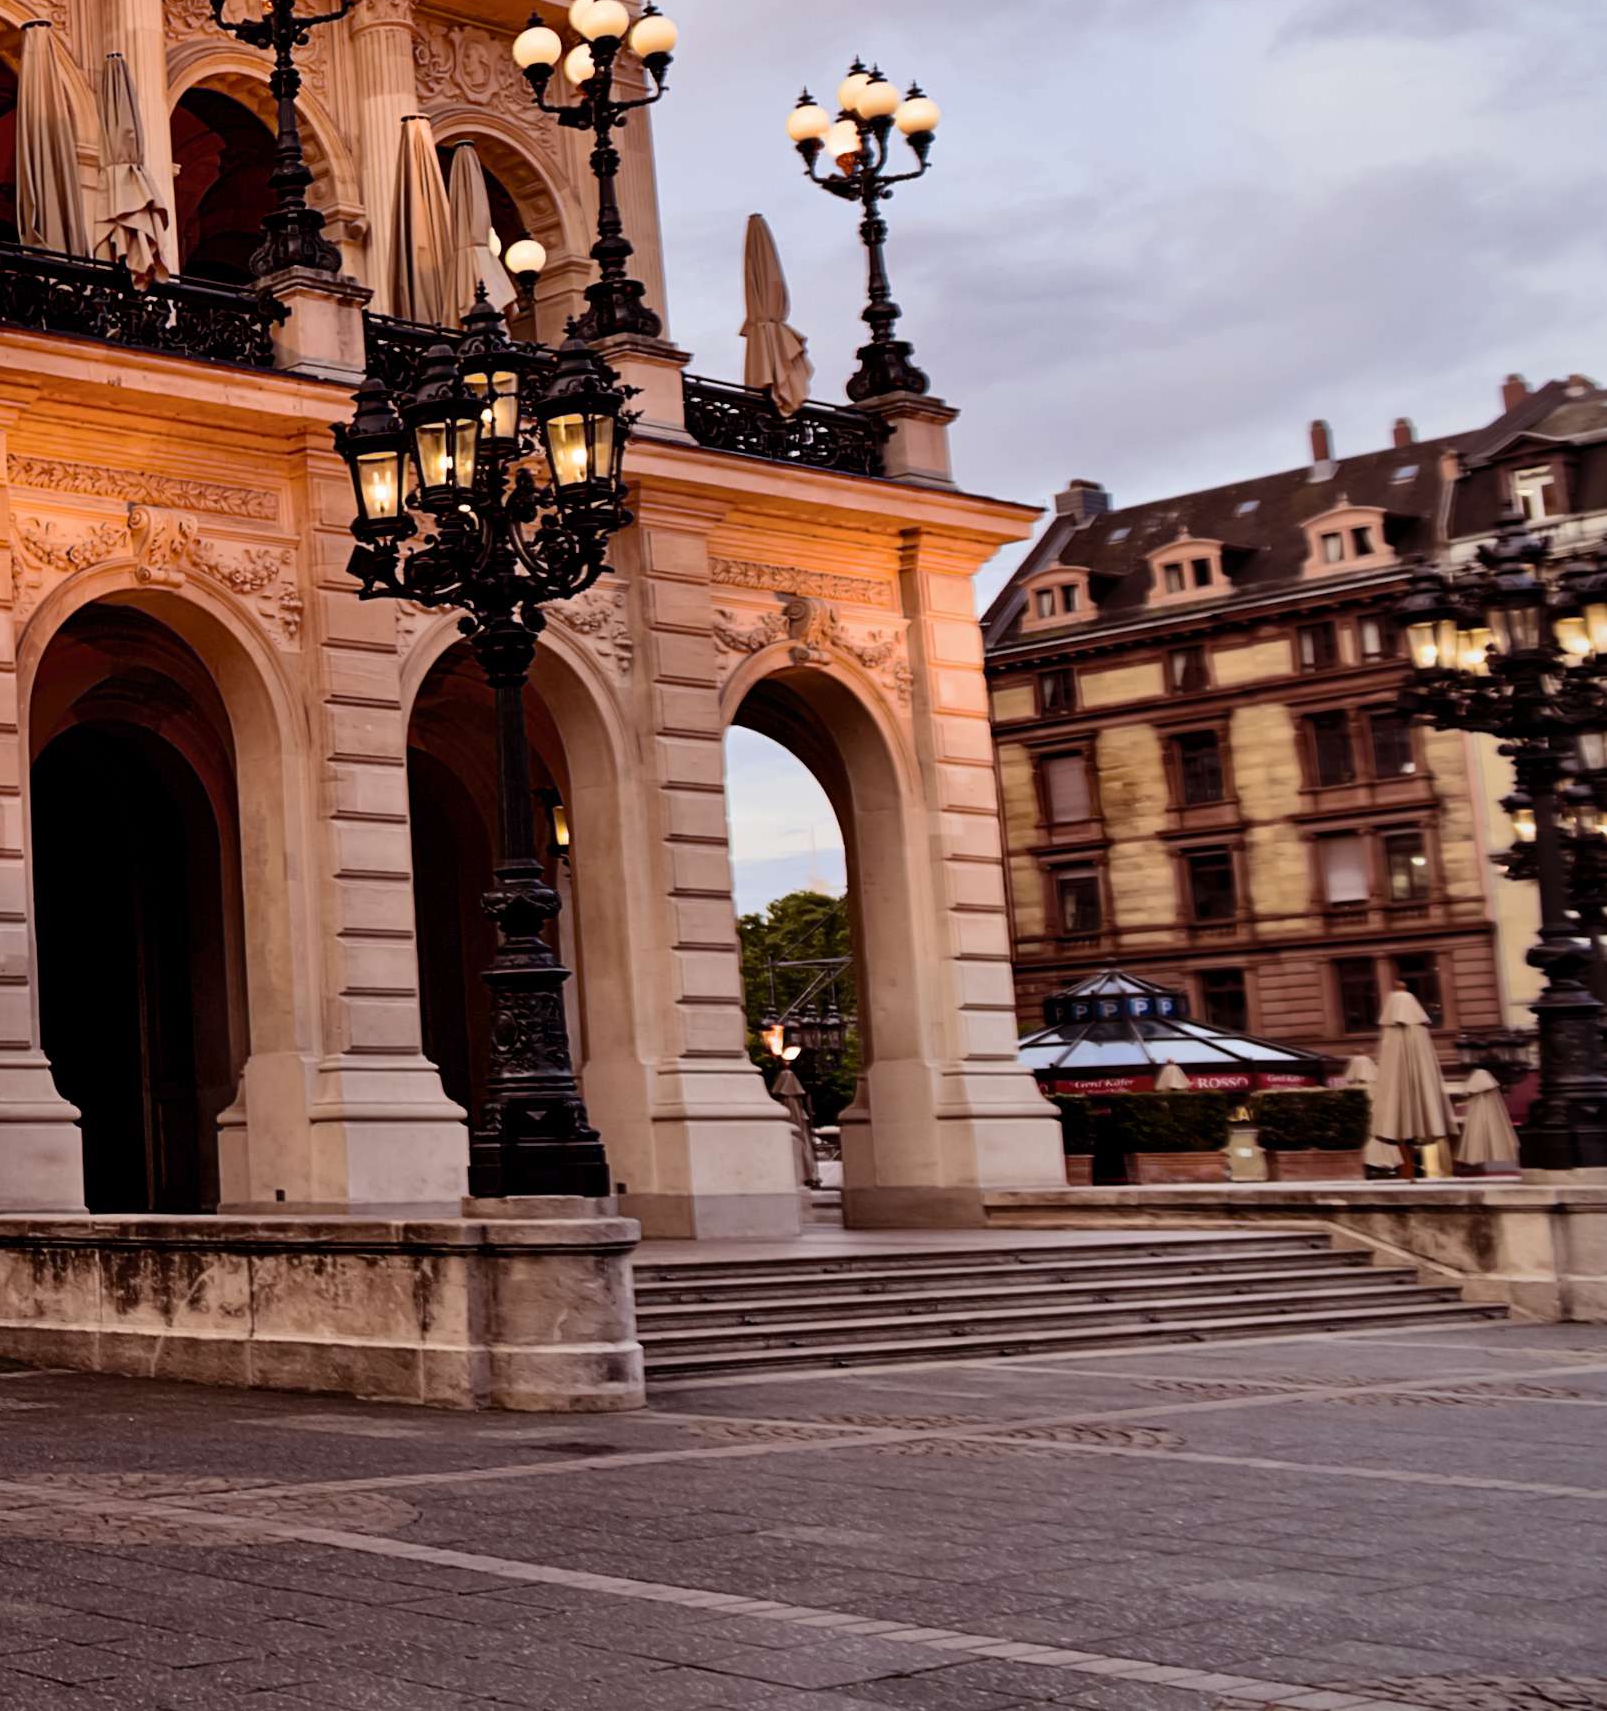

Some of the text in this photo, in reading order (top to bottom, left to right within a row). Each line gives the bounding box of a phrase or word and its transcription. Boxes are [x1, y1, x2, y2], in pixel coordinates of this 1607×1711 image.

[1075, 1004, 1088, 1021] P
[1103, 1003, 1118, 1018] P
[1133, 1001, 1148, 1016] P
[1161, 1001, 1172, 1016] P
[1197, 1077, 1249, 1089] ROSSO
